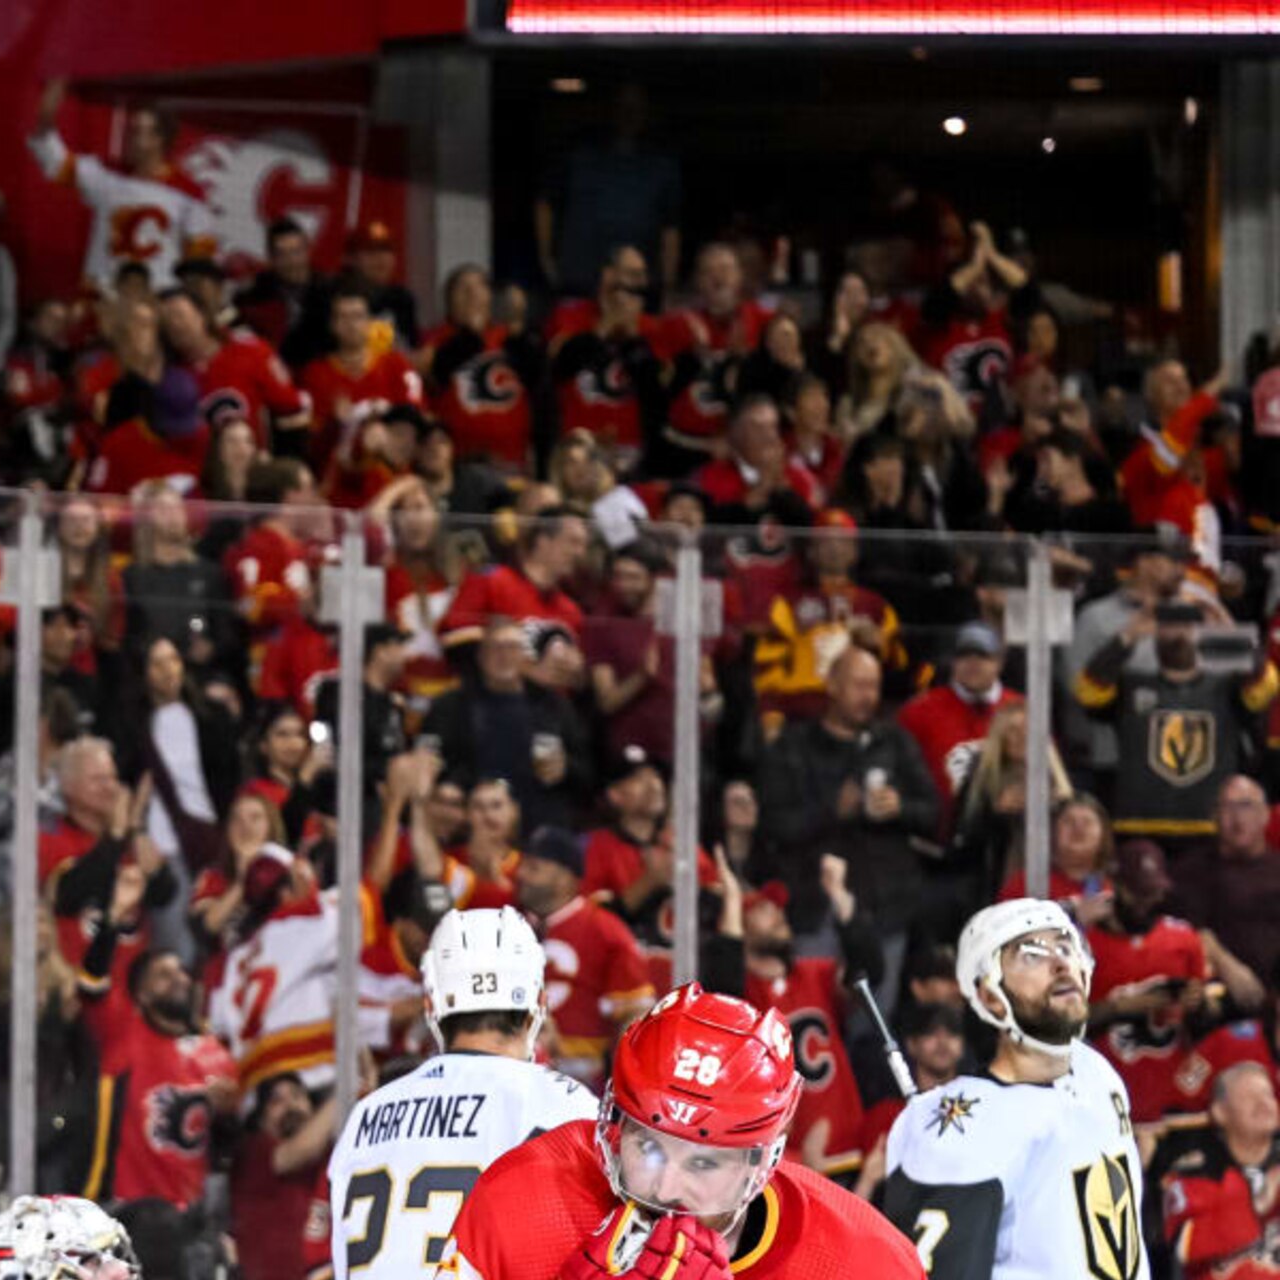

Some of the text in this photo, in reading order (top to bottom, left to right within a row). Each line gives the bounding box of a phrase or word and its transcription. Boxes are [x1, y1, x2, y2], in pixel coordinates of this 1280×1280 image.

[472, 972, 497, 994] 23
[673, 1048, 721, 1086] 28
[354, 1093, 487, 1148] MARTINEZ
